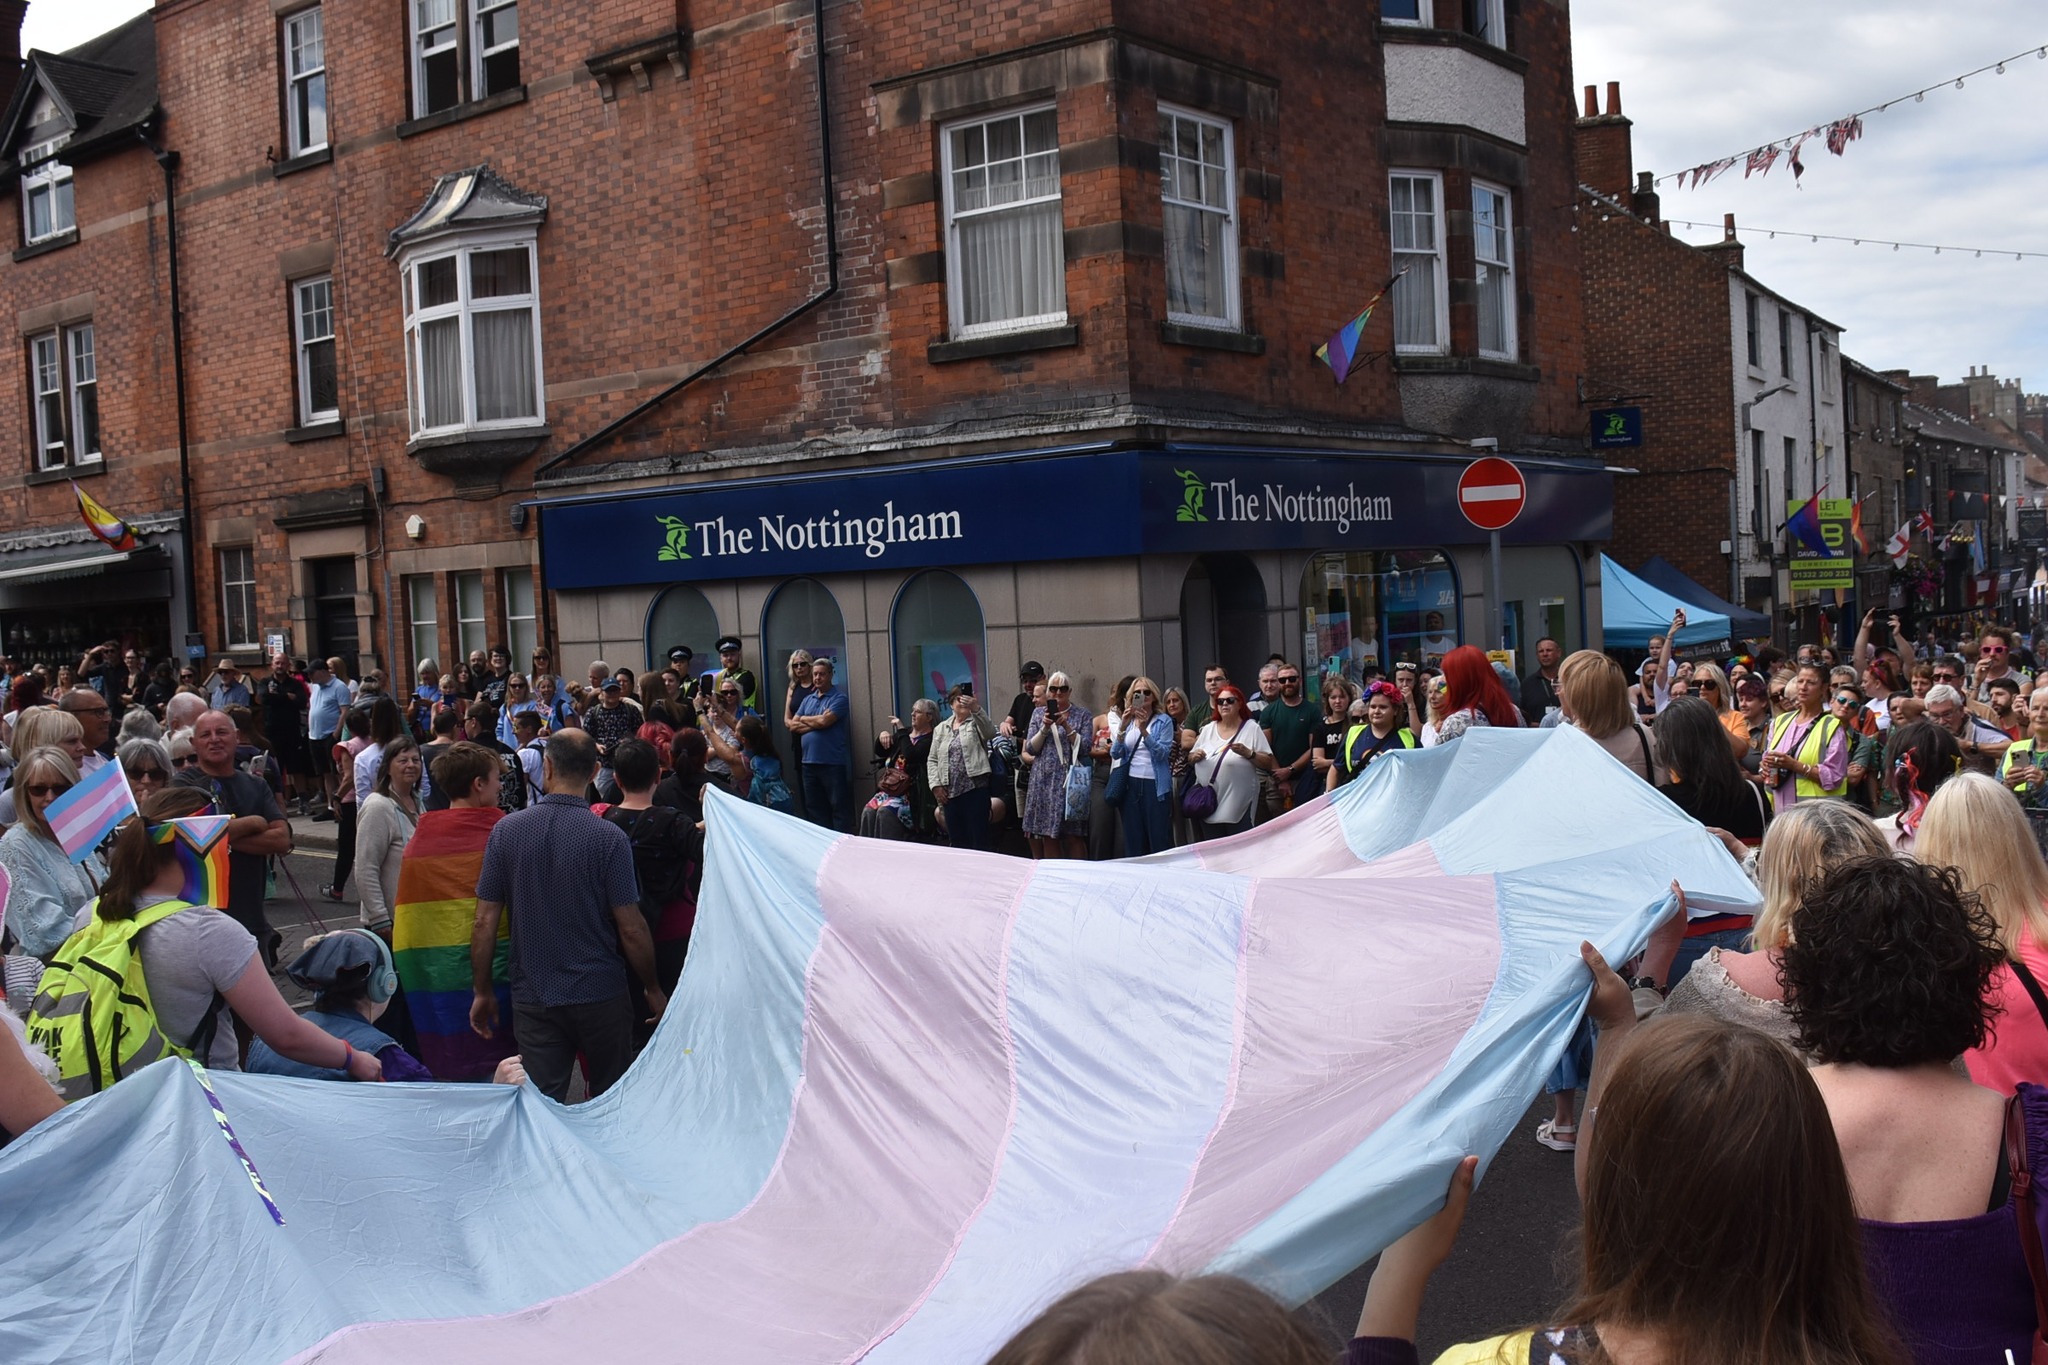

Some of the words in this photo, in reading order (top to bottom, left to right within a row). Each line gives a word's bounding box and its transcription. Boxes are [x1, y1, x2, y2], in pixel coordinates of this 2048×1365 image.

[1210, 477, 1260, 522] The
[1263, 481, 1393, 534] Nottingham
[1820, 501, 1837, 511] LET
[695, 516, 753, 556] The
[759, 500, 963, 558] Nottingham
[1797, 550, 1818, 558] DAVID
